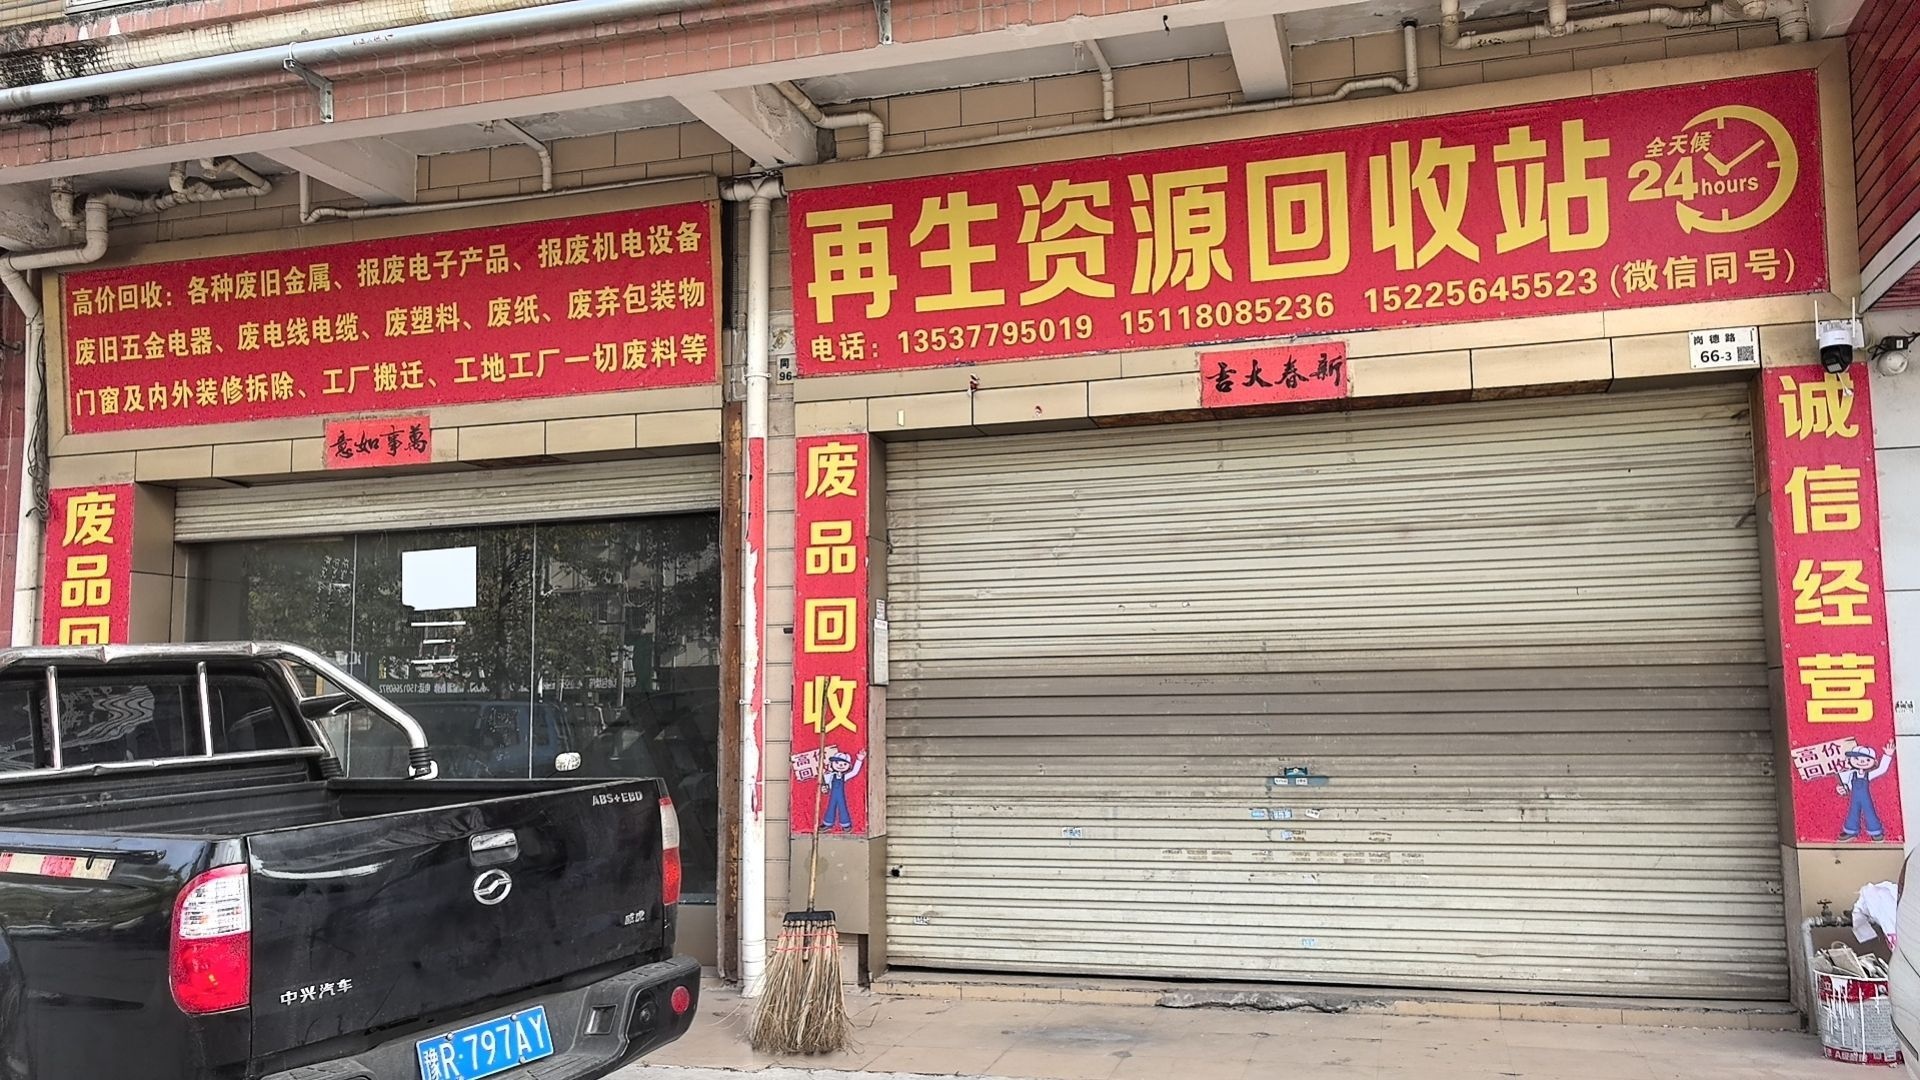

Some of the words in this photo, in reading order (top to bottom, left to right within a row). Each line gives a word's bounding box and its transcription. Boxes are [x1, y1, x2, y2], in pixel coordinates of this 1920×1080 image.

[1645, 131, 1712, 159] 全天候
[1628, 156, 1699, 202] 24
[1701, 176, 1759, 197] hours
[805, 118, 1611, 325] 再生资源回收站
[897, 314, 1094, 355] 13537795019
[1119, 291, 1335, 336] 15118085236
[1363, 267, 1599, 313] 15225645523
[1700, 349, 1732, 363] 66-3
[1778, 371, 1877, 724] 诚信经营
[804, 442, 858, 735] 废品回收
[1796, 742, 1841, 764] 高价
[1803, 758, 1850, 779] 回收
[592, 790, 644, 806] ABS+EBD
[280, 978, 353, 1006] 中兴汽车
